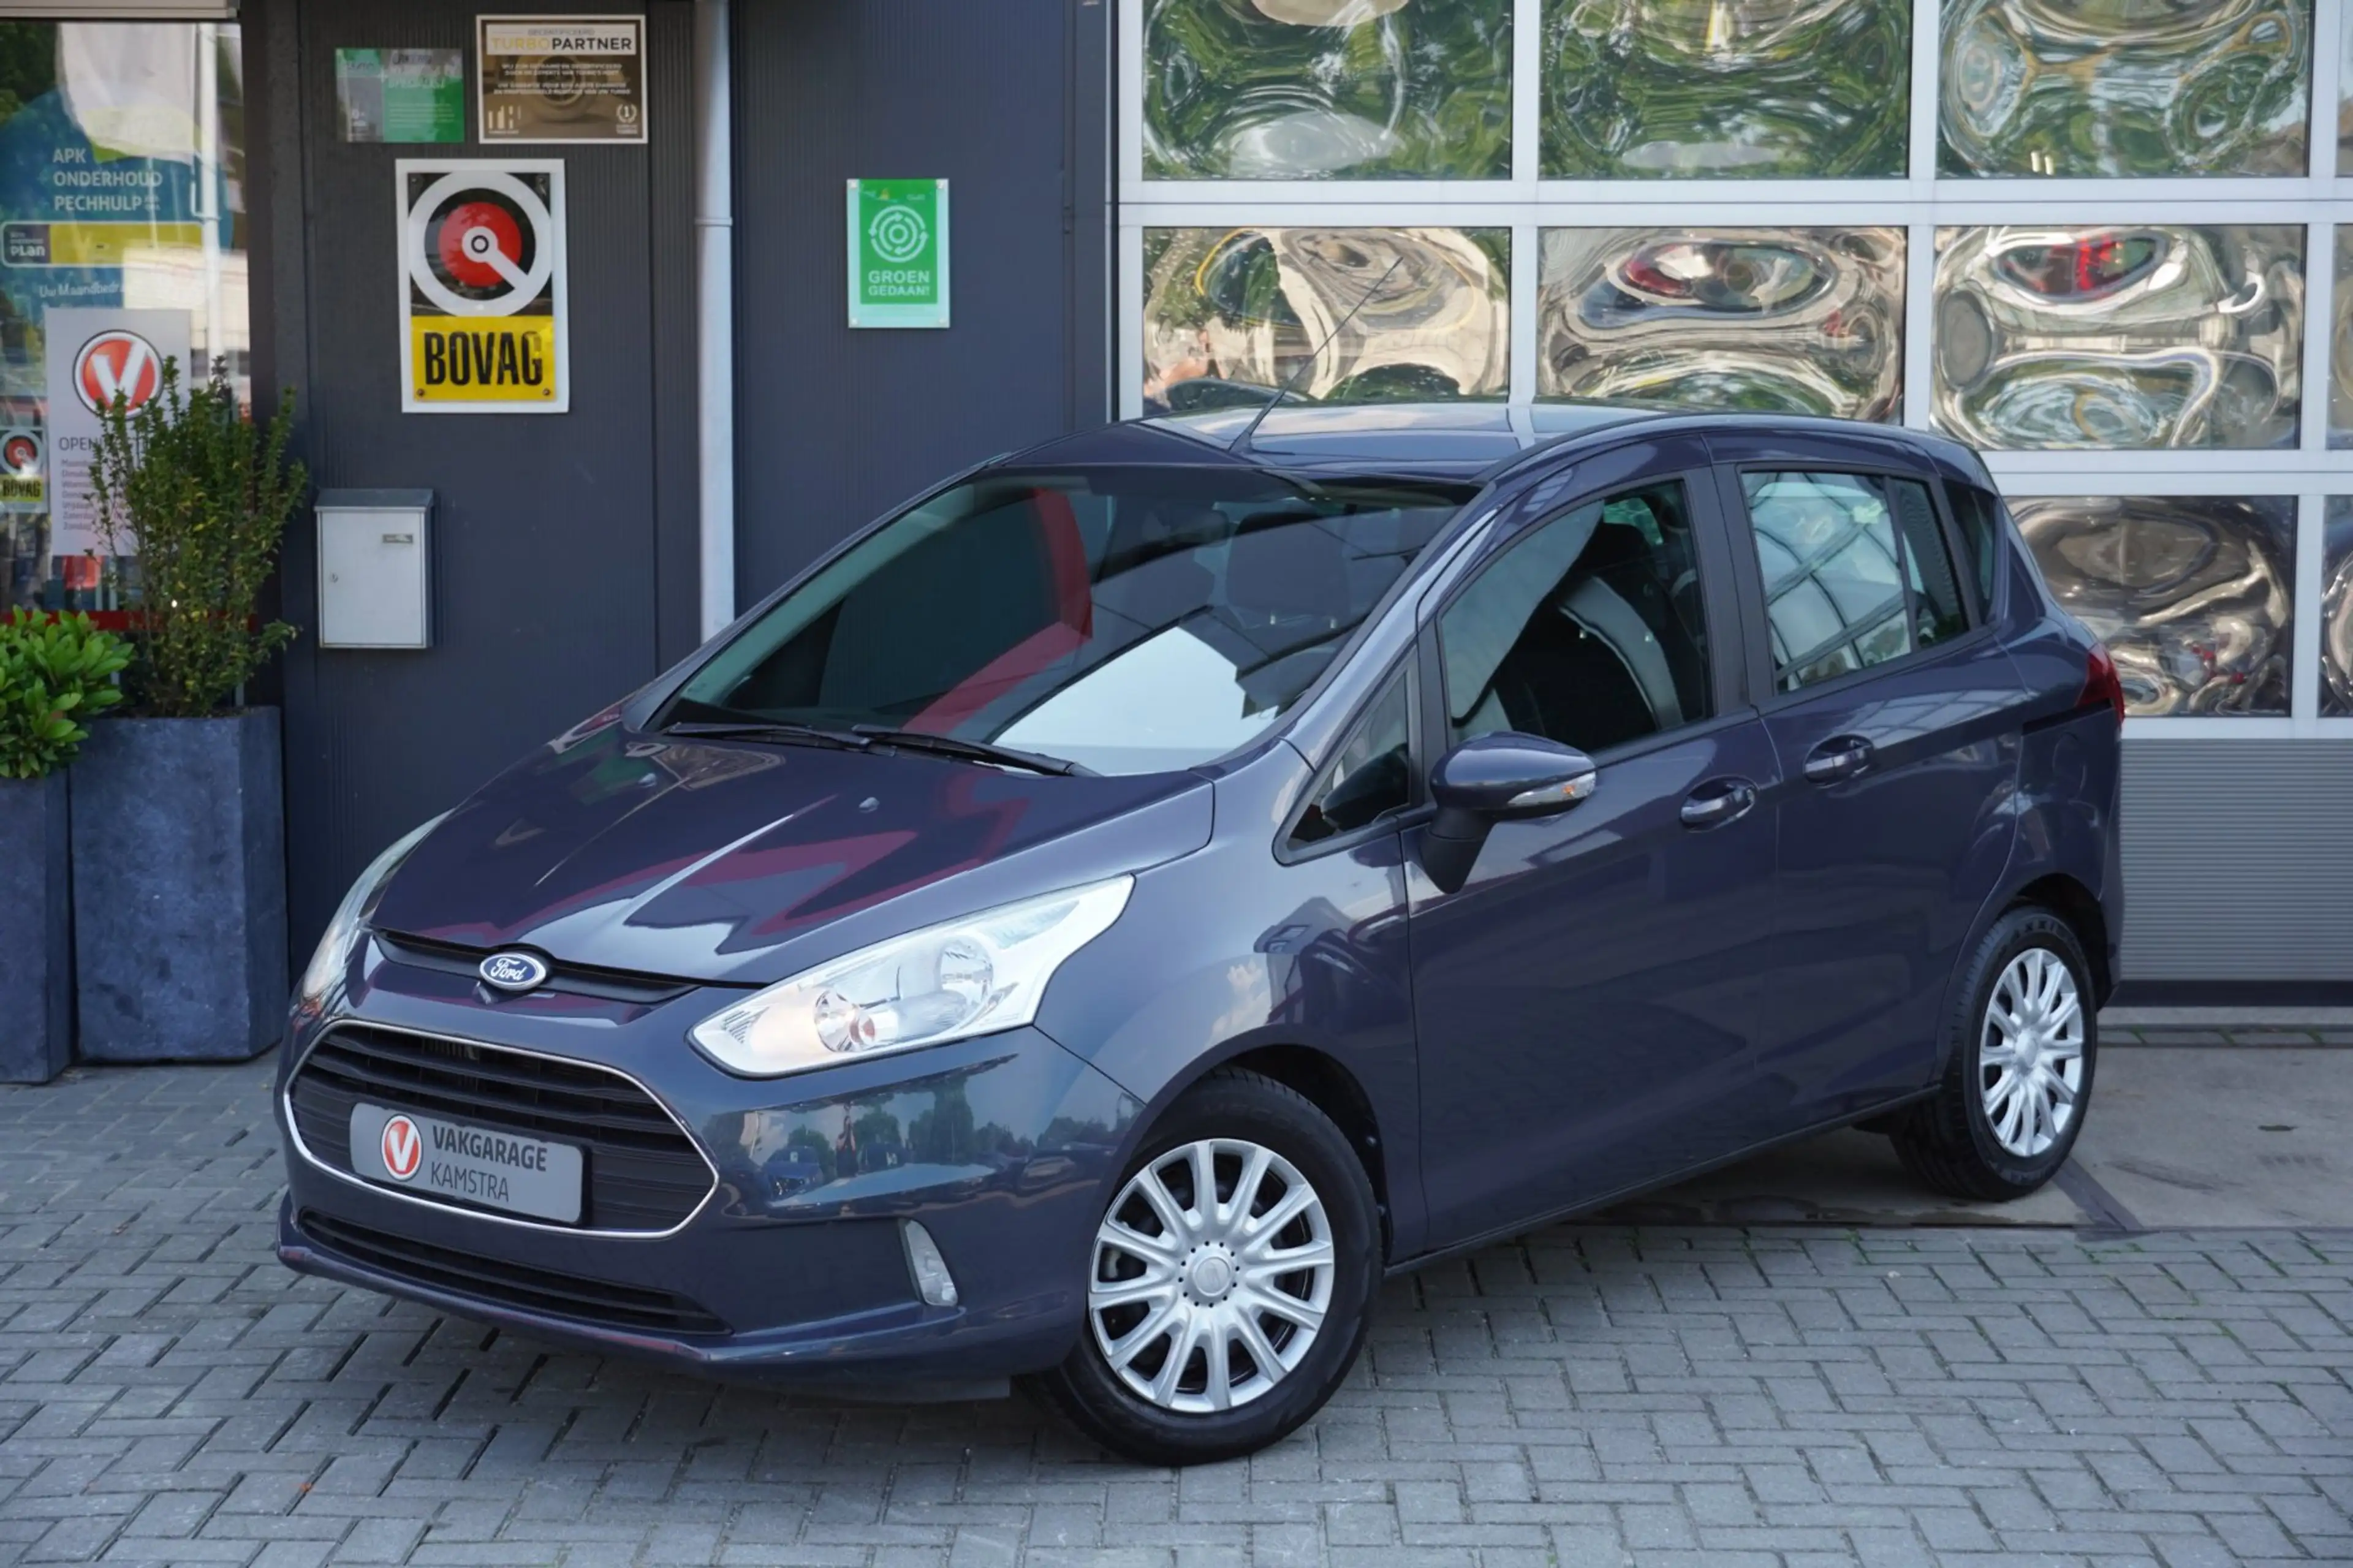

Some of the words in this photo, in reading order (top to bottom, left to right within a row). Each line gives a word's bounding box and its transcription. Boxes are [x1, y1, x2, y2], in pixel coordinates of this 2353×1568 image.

[53, 148, 86, 164] APK
[53, 171, 163, 187] ONDERHOUD
[55, 194, 142, 211] PECHHULP
[868, 270, 930, 284] GROEN
[424, 331, 544, 386] BOVAG
[3, 479, 41, 498] BOVAG
[491, 958, 528, 980] Ford
[433, 1125, 547, 1172] VAKGARAGE
[431, 1162, 509, 1202] KAMSTRA
